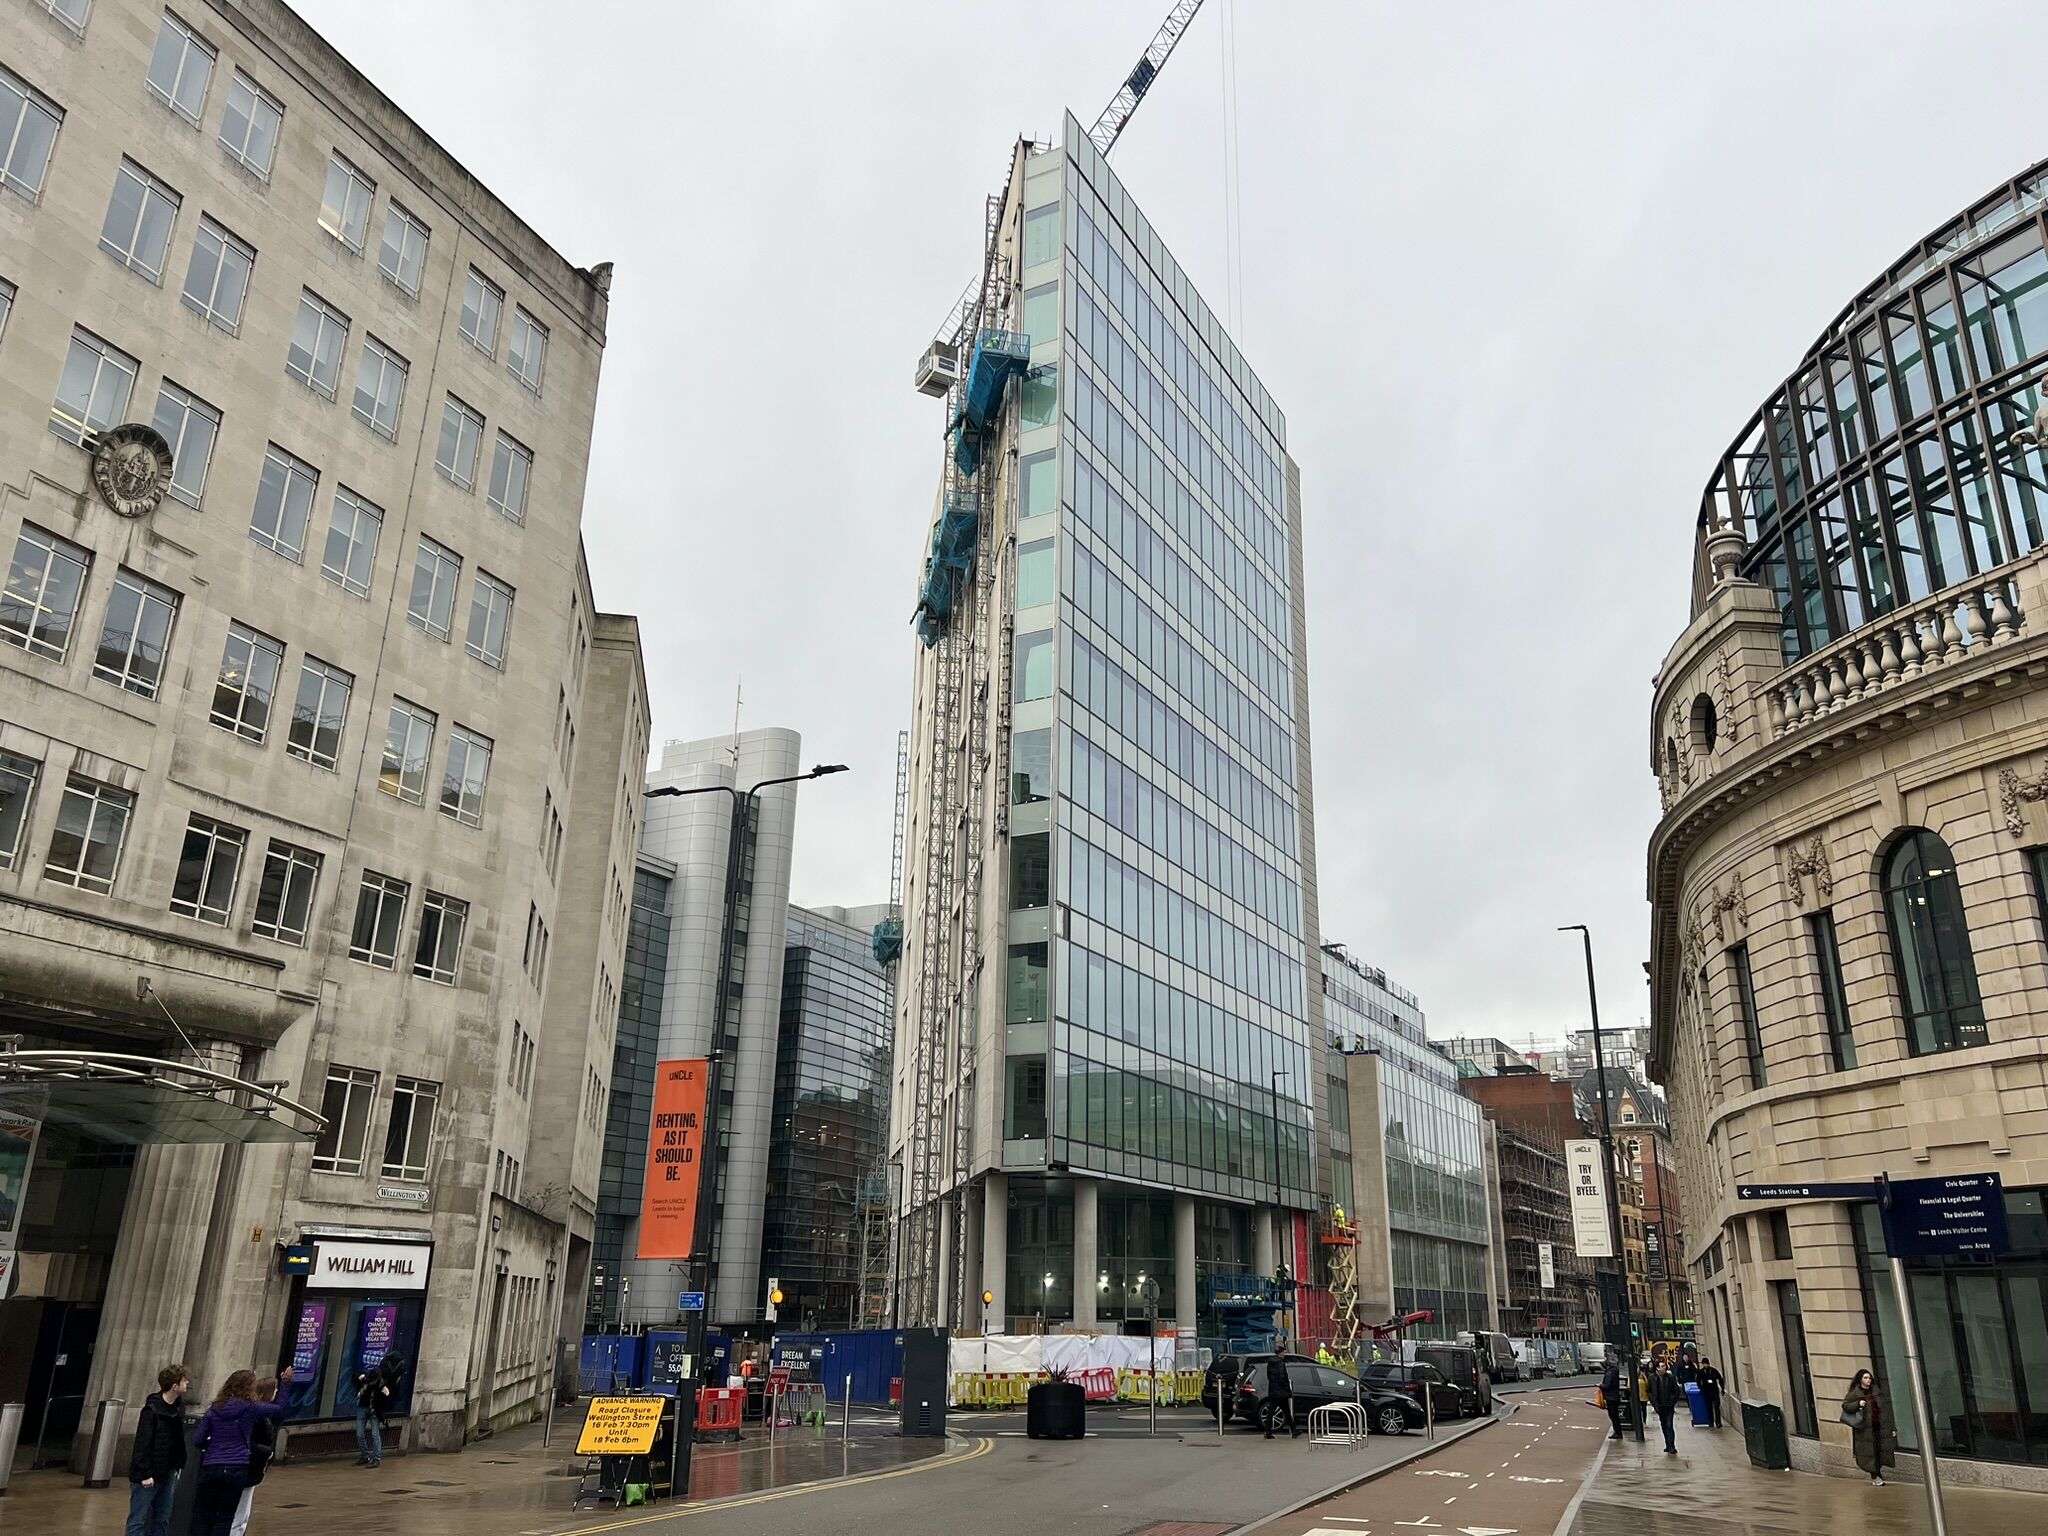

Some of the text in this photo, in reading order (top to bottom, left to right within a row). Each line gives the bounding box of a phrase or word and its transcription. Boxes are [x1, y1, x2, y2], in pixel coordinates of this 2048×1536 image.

[669, 1070, 693, 1080] UNCLE
[656, 1113, 698, 1130] RENTING,
[663, 1131, 688, 1146] AS IT
[655, 1148, 692, 1163] SHOULD
[666, 1166, 680, 1181] BE.
[1578, 1164, 1592, 1174] TRY
[1582, 1176, 1592, 1184] OR
[1945, 1180, 1958, 1188] Civic
[1576, 1186, 1599, 1196] BYEEE.
[1920, 1197, 1942, 1205] Financial
[1947, 1196, 1961, 1204] Legal
[328, 1257, 414, 1274] WILLIAM HILL
[671, 1344, 680, 1352] TO
[782, 1351, 803, 1359] BREEAM
[781, 1360, 810, 1370] EXCELLENT
